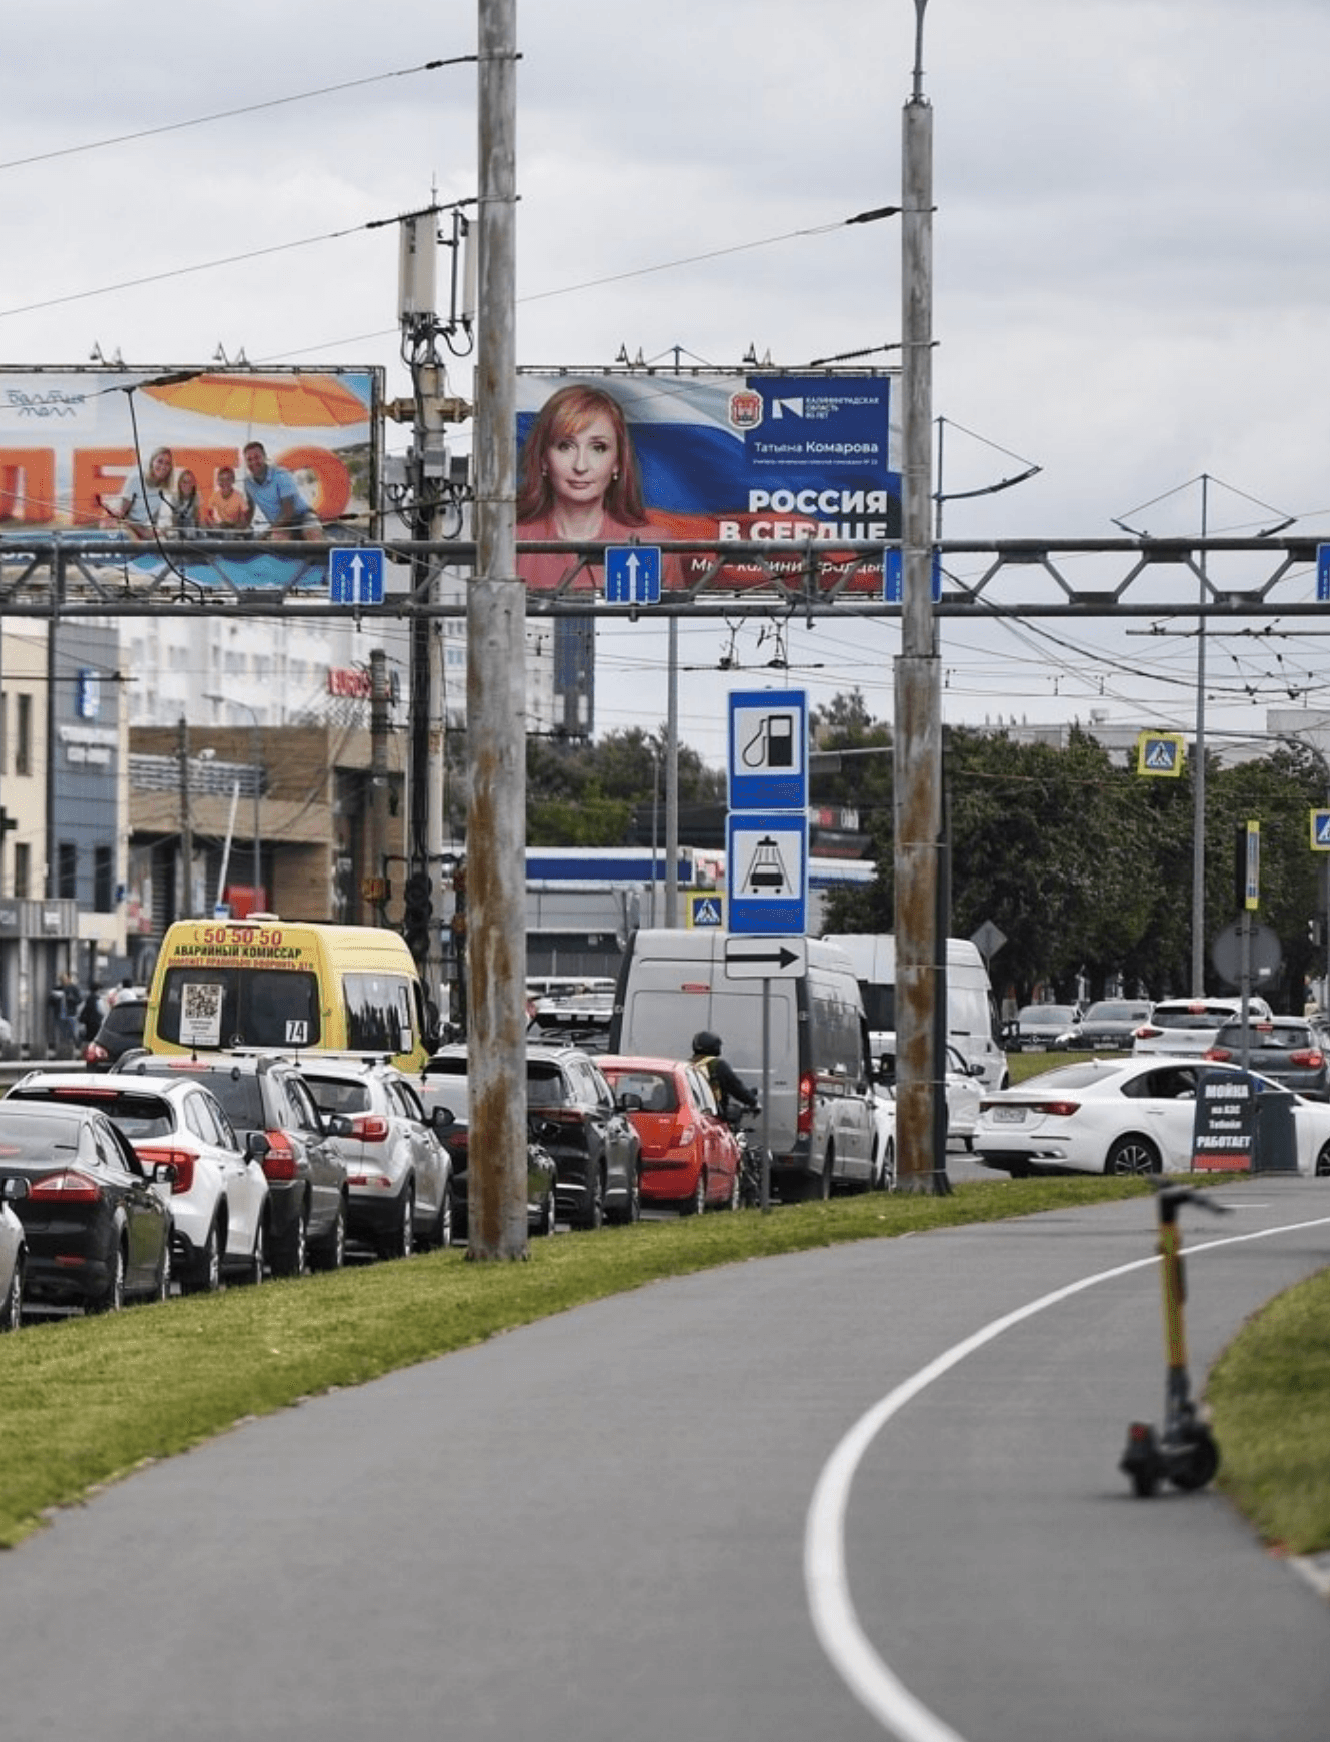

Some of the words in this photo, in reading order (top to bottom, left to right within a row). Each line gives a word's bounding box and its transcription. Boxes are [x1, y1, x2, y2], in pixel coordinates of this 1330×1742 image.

[754, 441, 803, 453] Татьяна
[806, 441, 879, 456] Комарова
[749, 489, 888, 514] РОССИЯ
[719, 522, 741, 541] В
[750, 522, 887, 541] СЕРДЦЕ
[174, 945, 239, 958] АВАРИЙНЫЙ
[242, 948, 302, 960] КОМИССАР
[289, 1022, 303, 1041] 74
[1205, 1083, 1249, 1098] МОЙКА
[1196, 1136, 1251, 1148] РАБОТАЕТ
